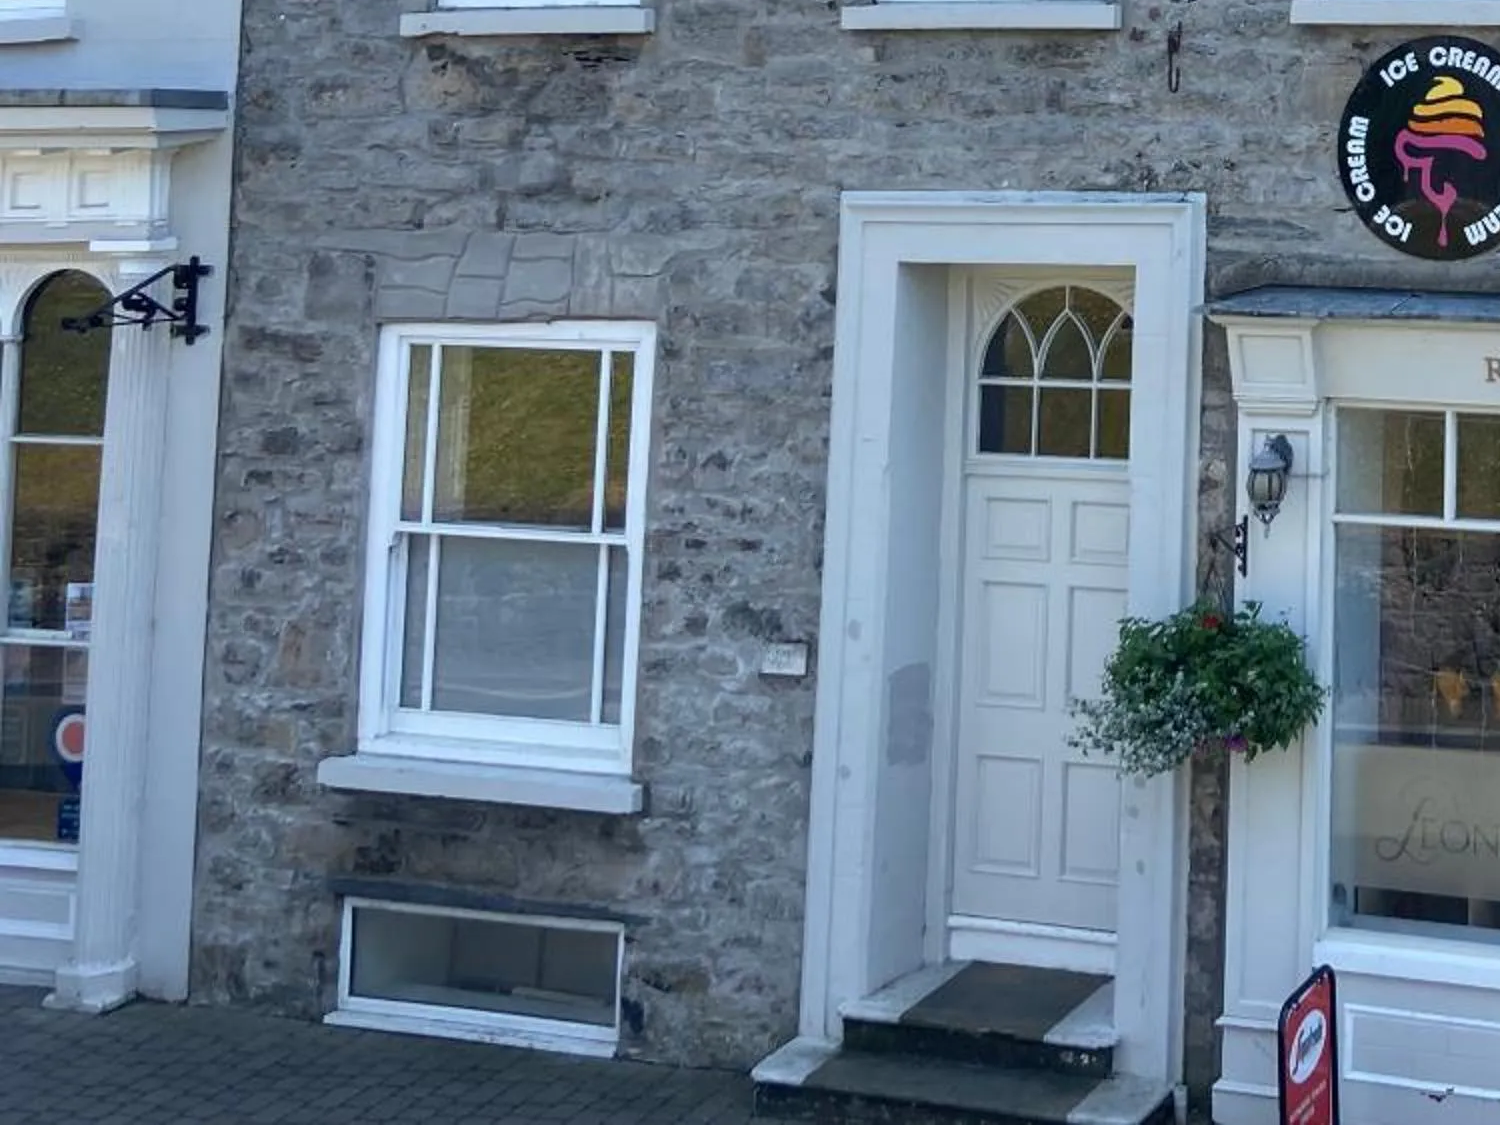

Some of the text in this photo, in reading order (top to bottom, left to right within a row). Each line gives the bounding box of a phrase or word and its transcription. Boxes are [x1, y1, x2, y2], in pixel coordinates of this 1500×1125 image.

[1379, 51, 1419, 88] ICE
[1346, 115, 1414, 243] ICE CREAM
